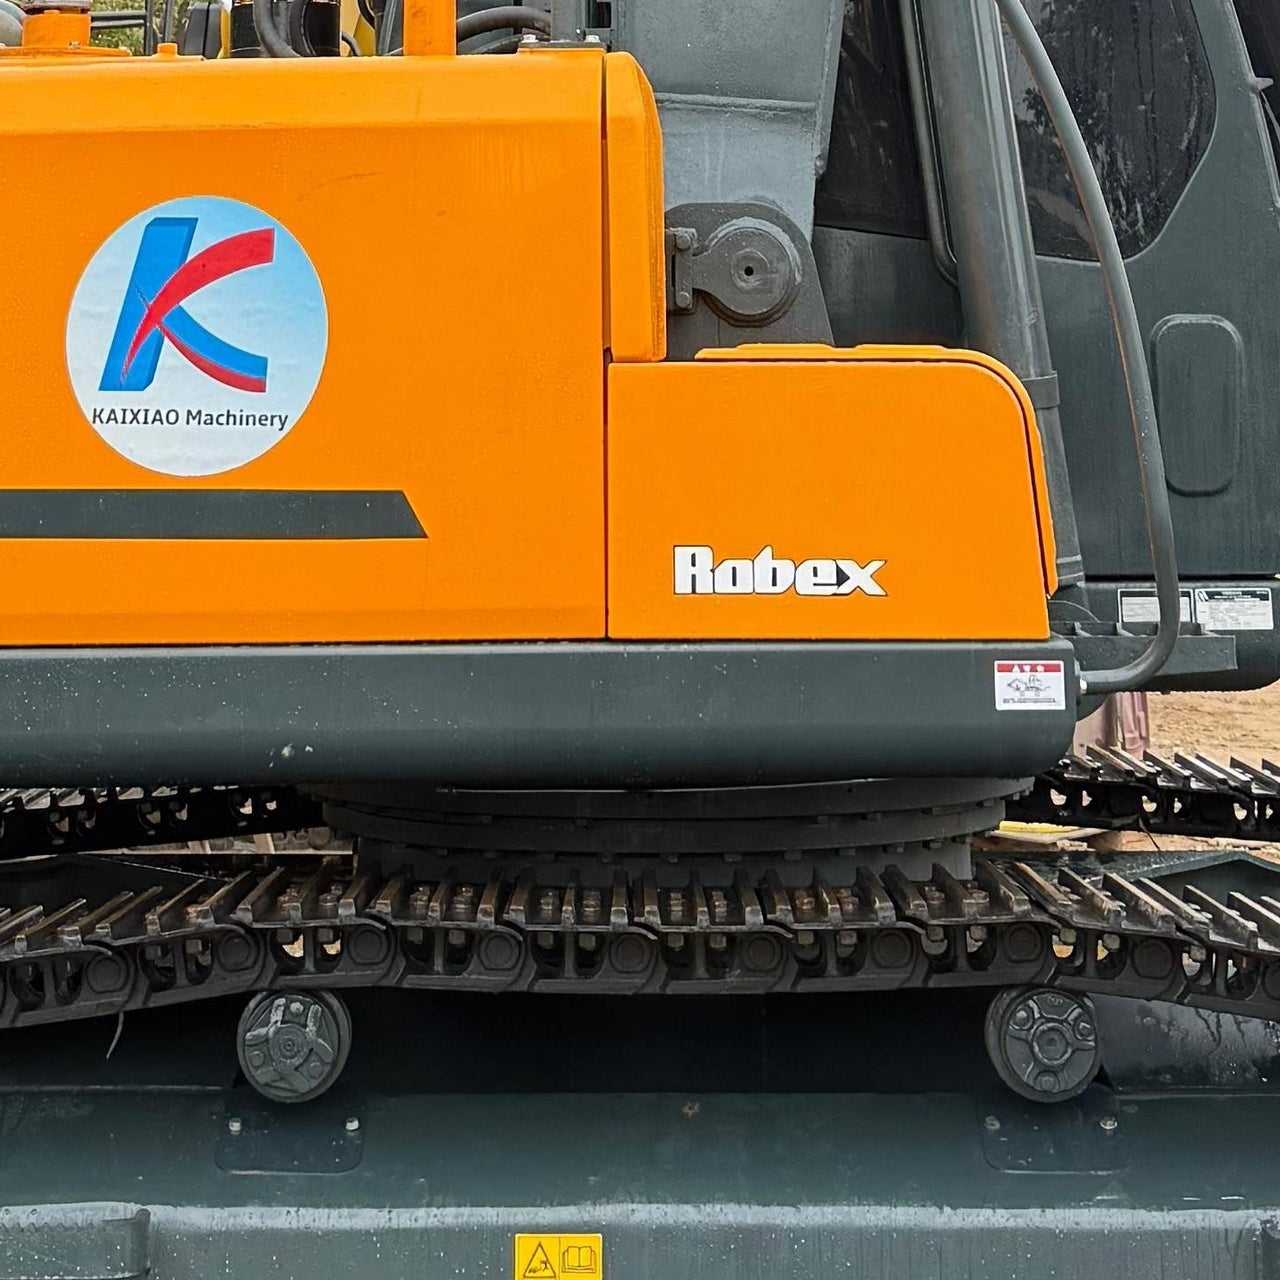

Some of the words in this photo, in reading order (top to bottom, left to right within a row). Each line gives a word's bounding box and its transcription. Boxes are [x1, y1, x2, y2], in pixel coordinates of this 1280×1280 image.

[91, 407, 180, 426] KAIXIAO
[185, 408, 289, 432] Machinery
[673, 544, 889, 597] Robex
